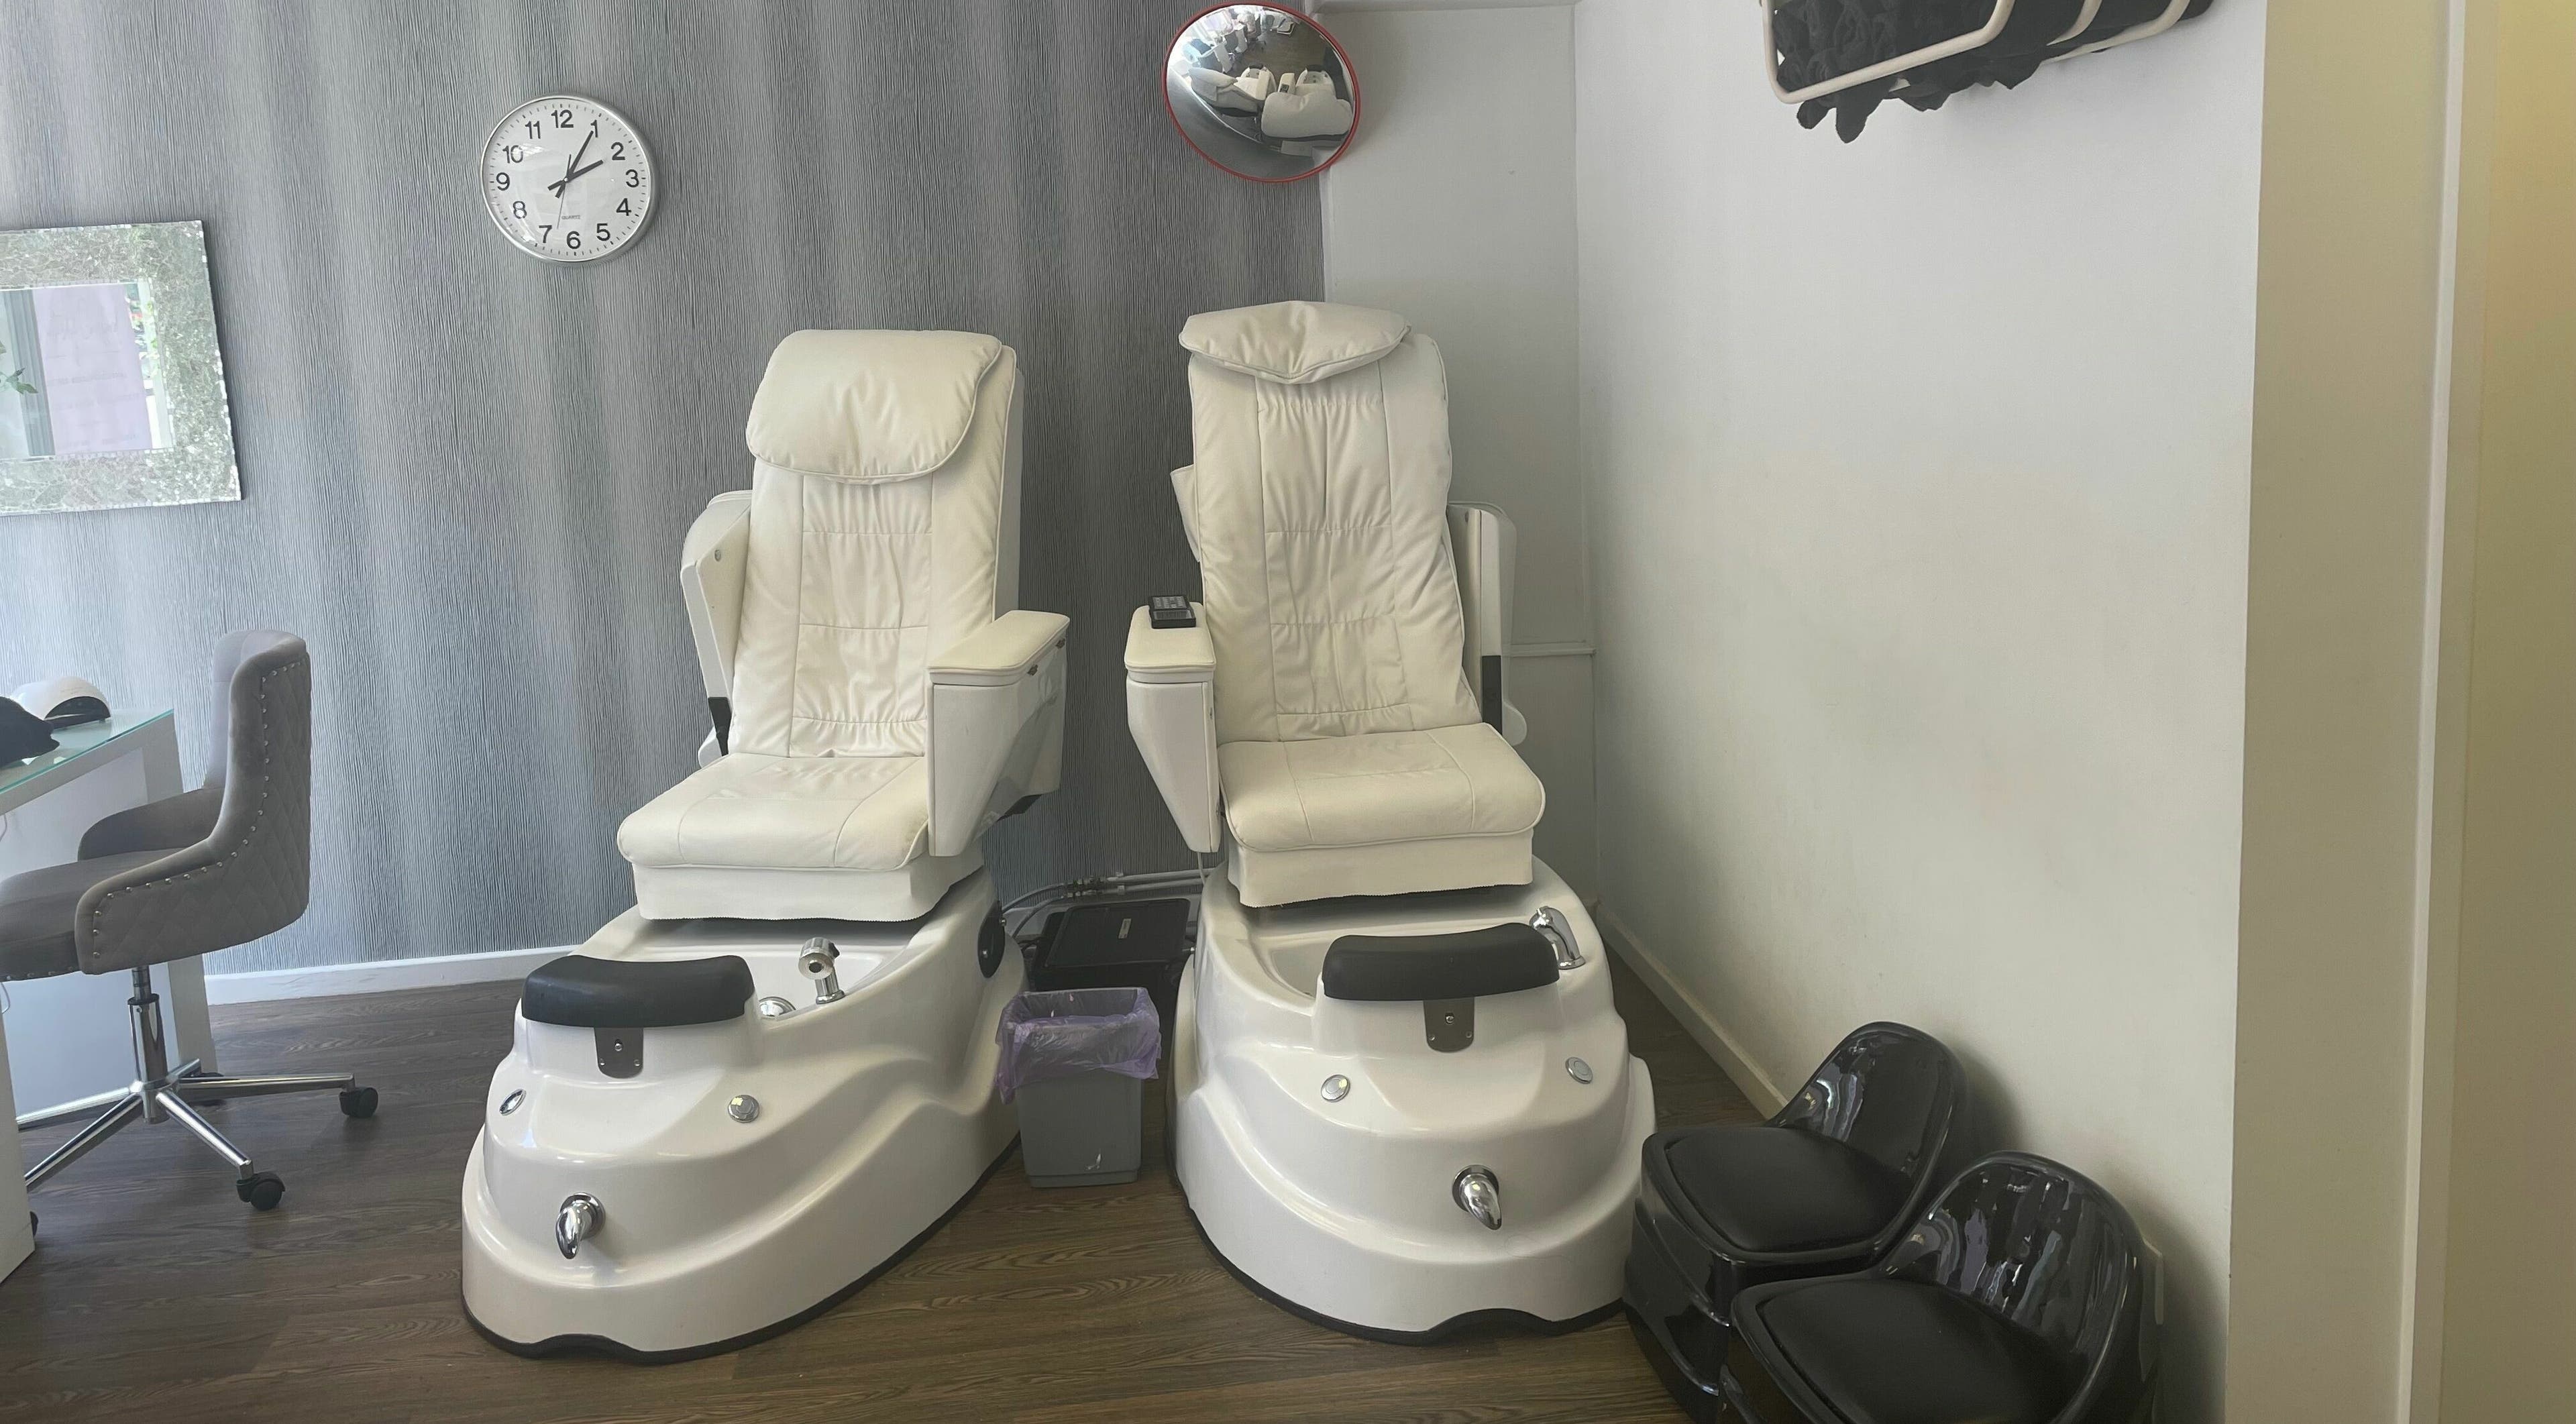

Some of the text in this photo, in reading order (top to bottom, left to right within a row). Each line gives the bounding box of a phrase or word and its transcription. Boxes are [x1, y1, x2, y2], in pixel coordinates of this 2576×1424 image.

[551, 109, 574, 128] 12
[525, 121, 541, 139] 11
[590, 119, 598, 138] 1
[502, 145, 524, 163] 10
[610, 142, 625, 160] 2
[496, 172, 510, 190] 9
[625, 169, 639, 188] 3
[513, 201, 527, 219] 8
[616, 198, 632, 216] 4
[539, 225, 552, 243] 7
[566, 231, 581, 250] 6
[596, 223, 610, 241] 5
